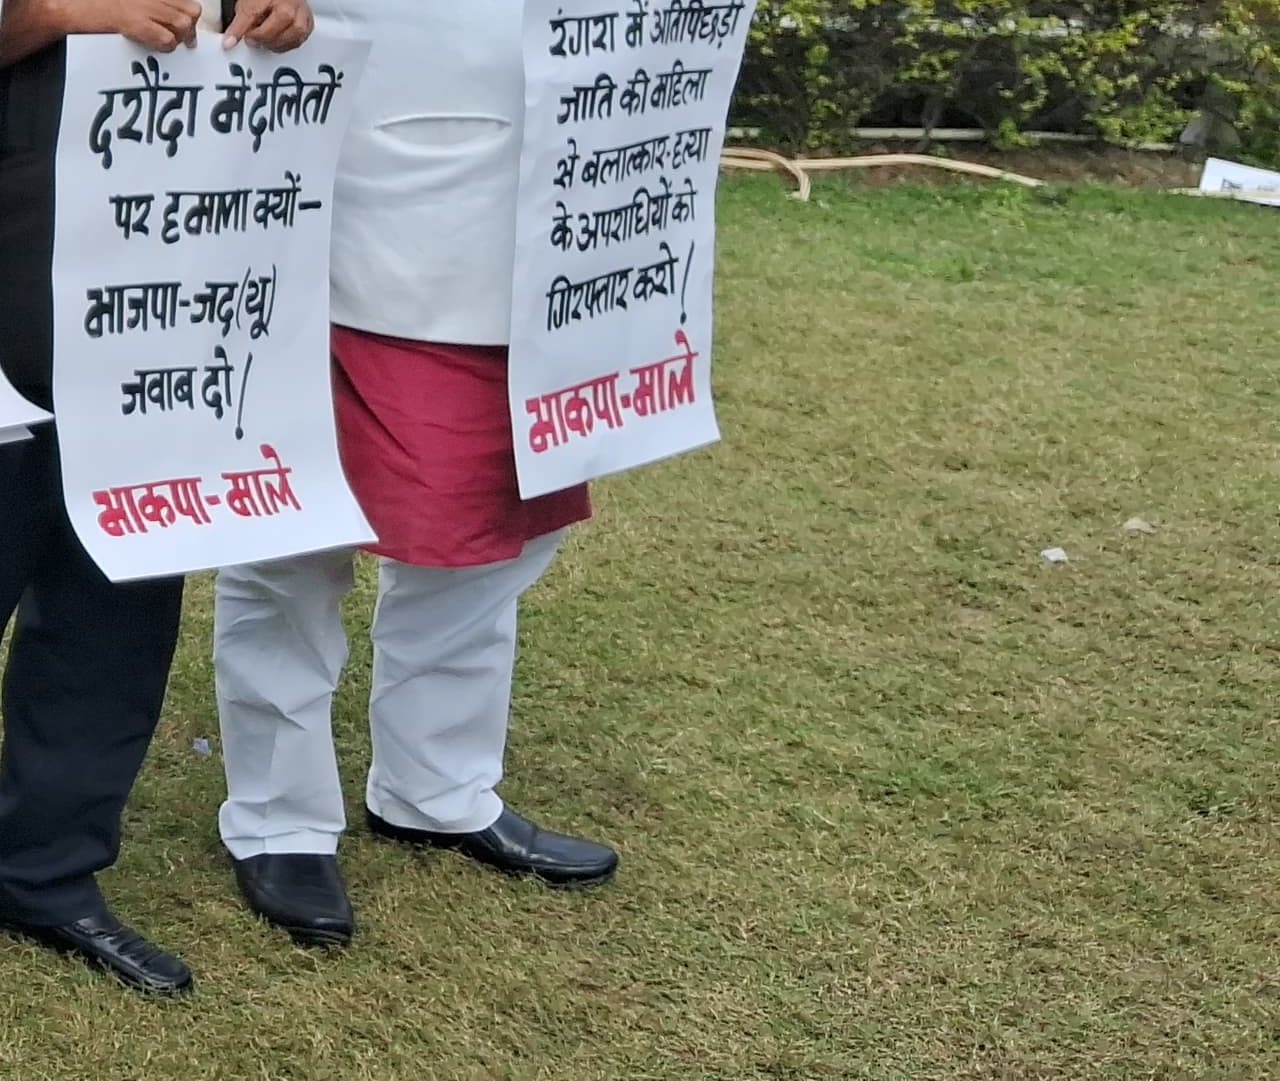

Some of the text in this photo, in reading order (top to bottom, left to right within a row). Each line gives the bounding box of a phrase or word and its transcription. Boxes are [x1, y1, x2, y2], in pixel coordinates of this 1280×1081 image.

[549, 9, 619, 56] रंगरा
[211, 64, 253, 134] में
[246, 64, 344, 153] दलितों
[558, 60, 713, 124] जाति की महिला
[553, 138, 580, 189] से
[109, 195, 155, 239] पर
[550, 201, 573, 251] के
[671, 178, 697, 222] को
[122, 368, 197, 415] जवाब
